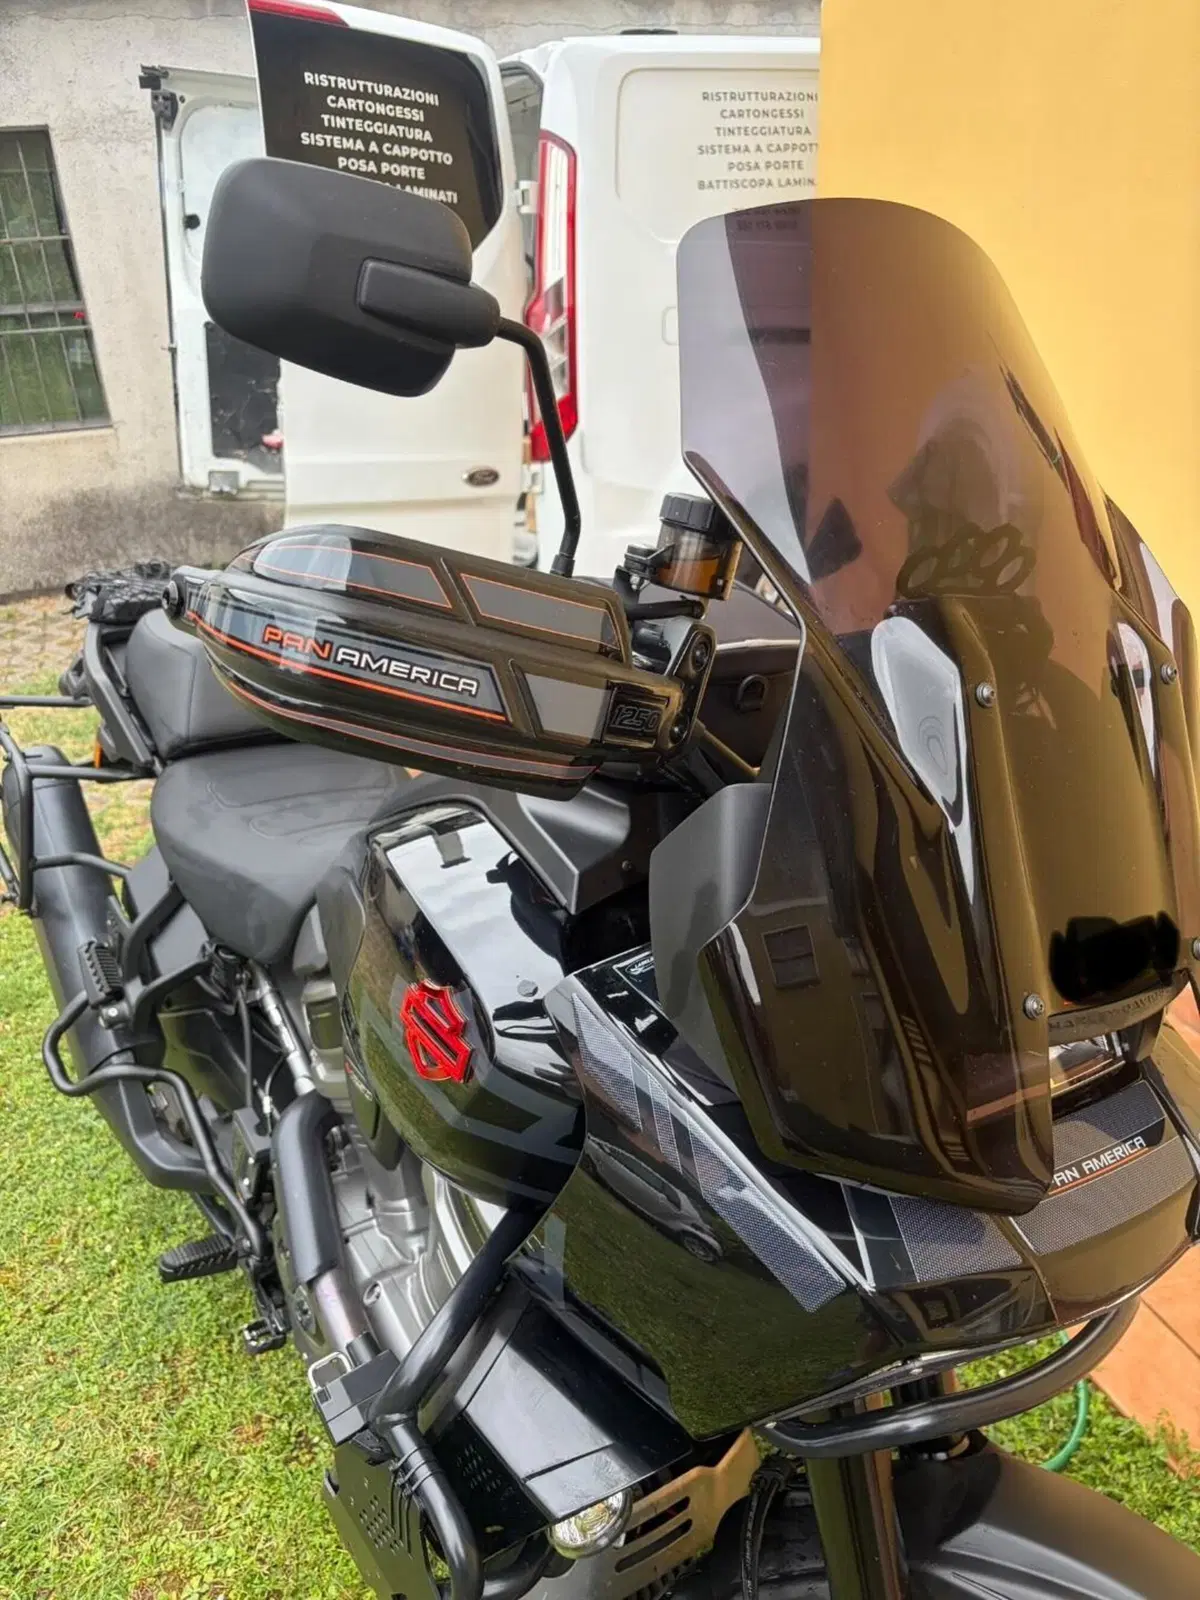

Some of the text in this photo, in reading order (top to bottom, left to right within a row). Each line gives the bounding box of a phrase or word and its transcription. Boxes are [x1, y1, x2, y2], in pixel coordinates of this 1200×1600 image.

[304, 71, 439, 106] RISTRUTTURAZIONI
[702, 91, 818, 102] RISTRUTTURAZIONI
[326, 95, 425, 122] CARTONGESSI
[719, 108, 804, 119] CARTONGESSI
[321, 114, 433, 143] TINTEGGIATURA
[715, 125, 812, 137] TINTEGGIATURA
[300, 132, 453, 165] SISTEMA A CAPPOTTO
[697, 143, 751, 155] SISTEMA
[755, 143, 763, 153] A
[337, 156, 426, 180] POSA PORTE
[728, 160, 804, 172] POSA PORTE
[697, 178, 773, 191] BATTISCOPA
[263, 624, 478, 696] PAN AMERICA
[609, 703, 662, 733] 1250
[1051, 1135, 1147, 1187] AN AMERICA
